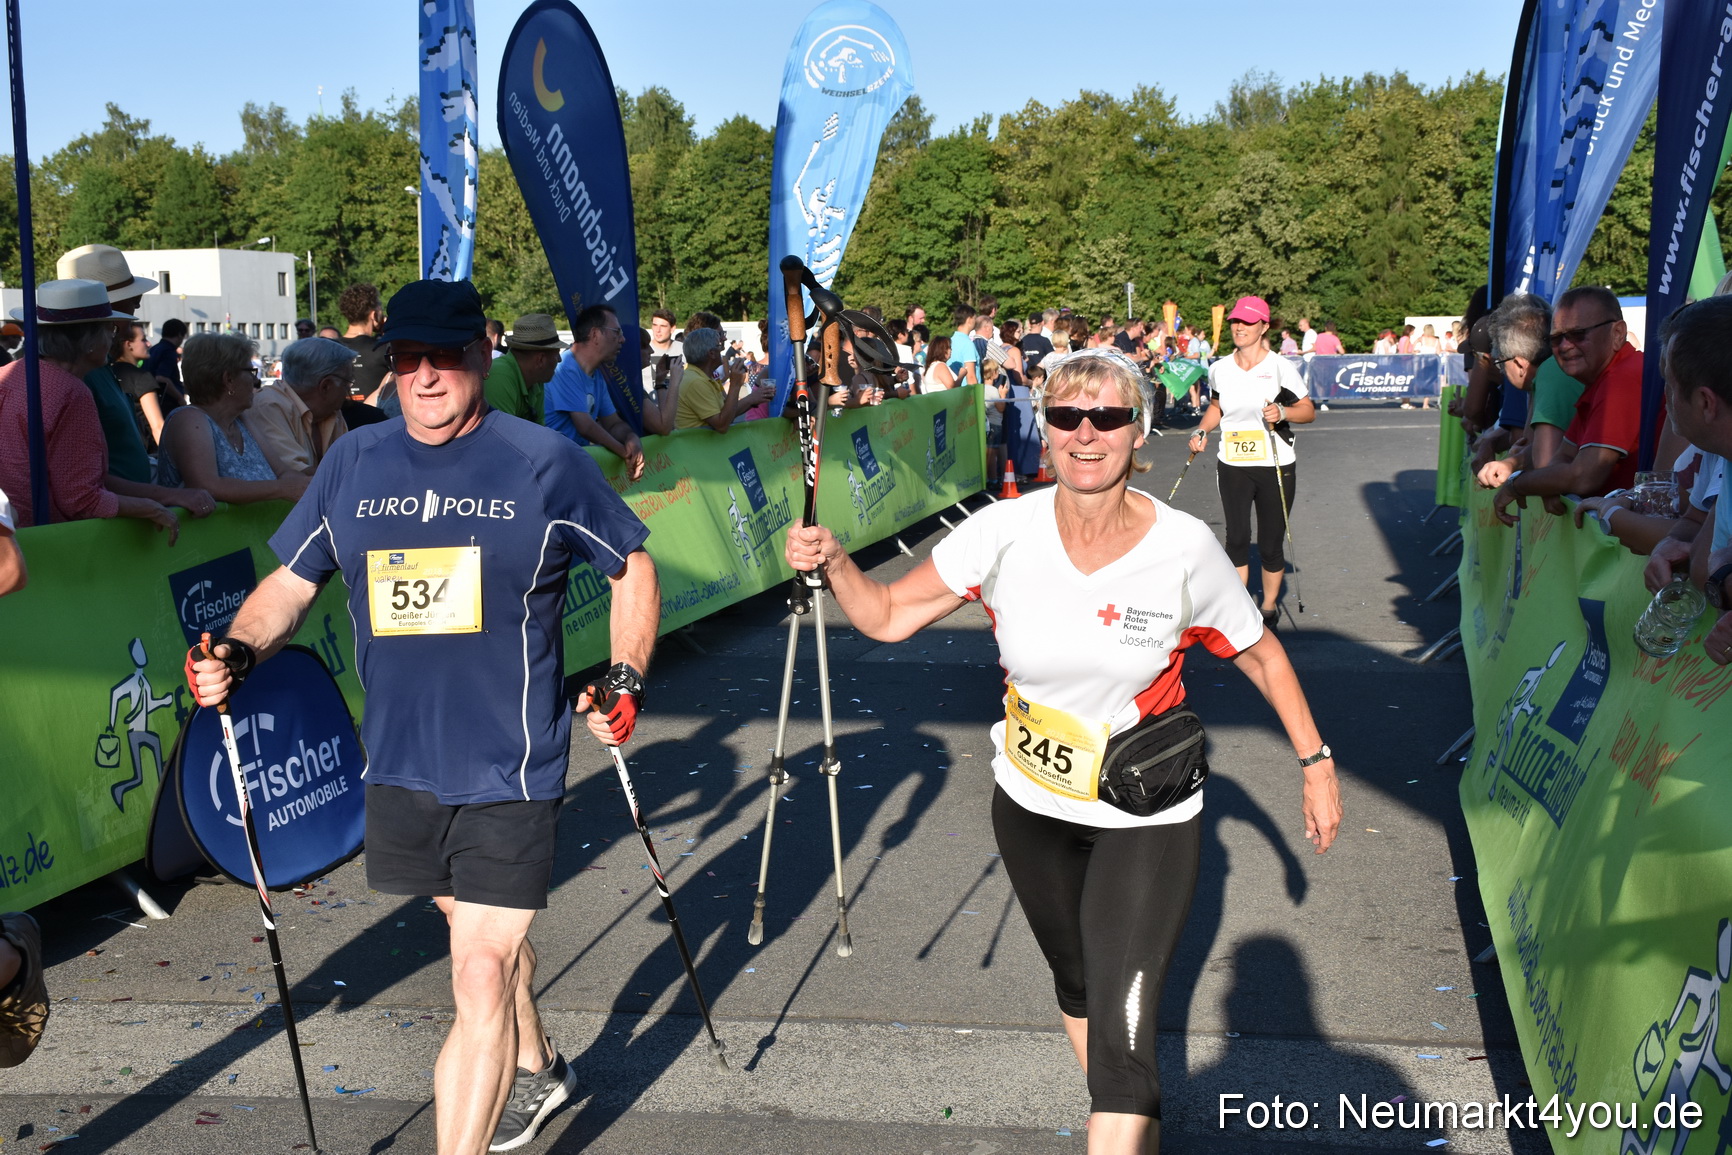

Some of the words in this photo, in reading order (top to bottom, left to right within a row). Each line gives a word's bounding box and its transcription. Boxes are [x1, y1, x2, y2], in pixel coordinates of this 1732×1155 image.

[1606, 46, 1635, 89] und
[1349, 372, 1415, 386] Fischer
[1355, 385, 1409, 393] AUTOMOBILE
[1233, 441, 1256, 453] 762
[355, 497, 419, 518] EURO
[442, 498, 515, 520] POLES
[391, 578, 450, 610] 534
[194, 589, 246, 623] Fischer
[391, 611, 423, 620] Queißer
[1126, 606, 1174, 620] Bayerisches
[1123, 622, 1147, 632] Kreuz
[1125, 614, 1148, 624] Rotes
[1119, 634, 1164, 649] Josefine
[1018, 725, 1074, 774] 245
[242, 735, 341, 810] Fischer
[1016, 750, 1037, 769] Glaser
[1037, 766, 1073, 786] Josefine
[267, 775, 349, 832] AUTOMOBILE
